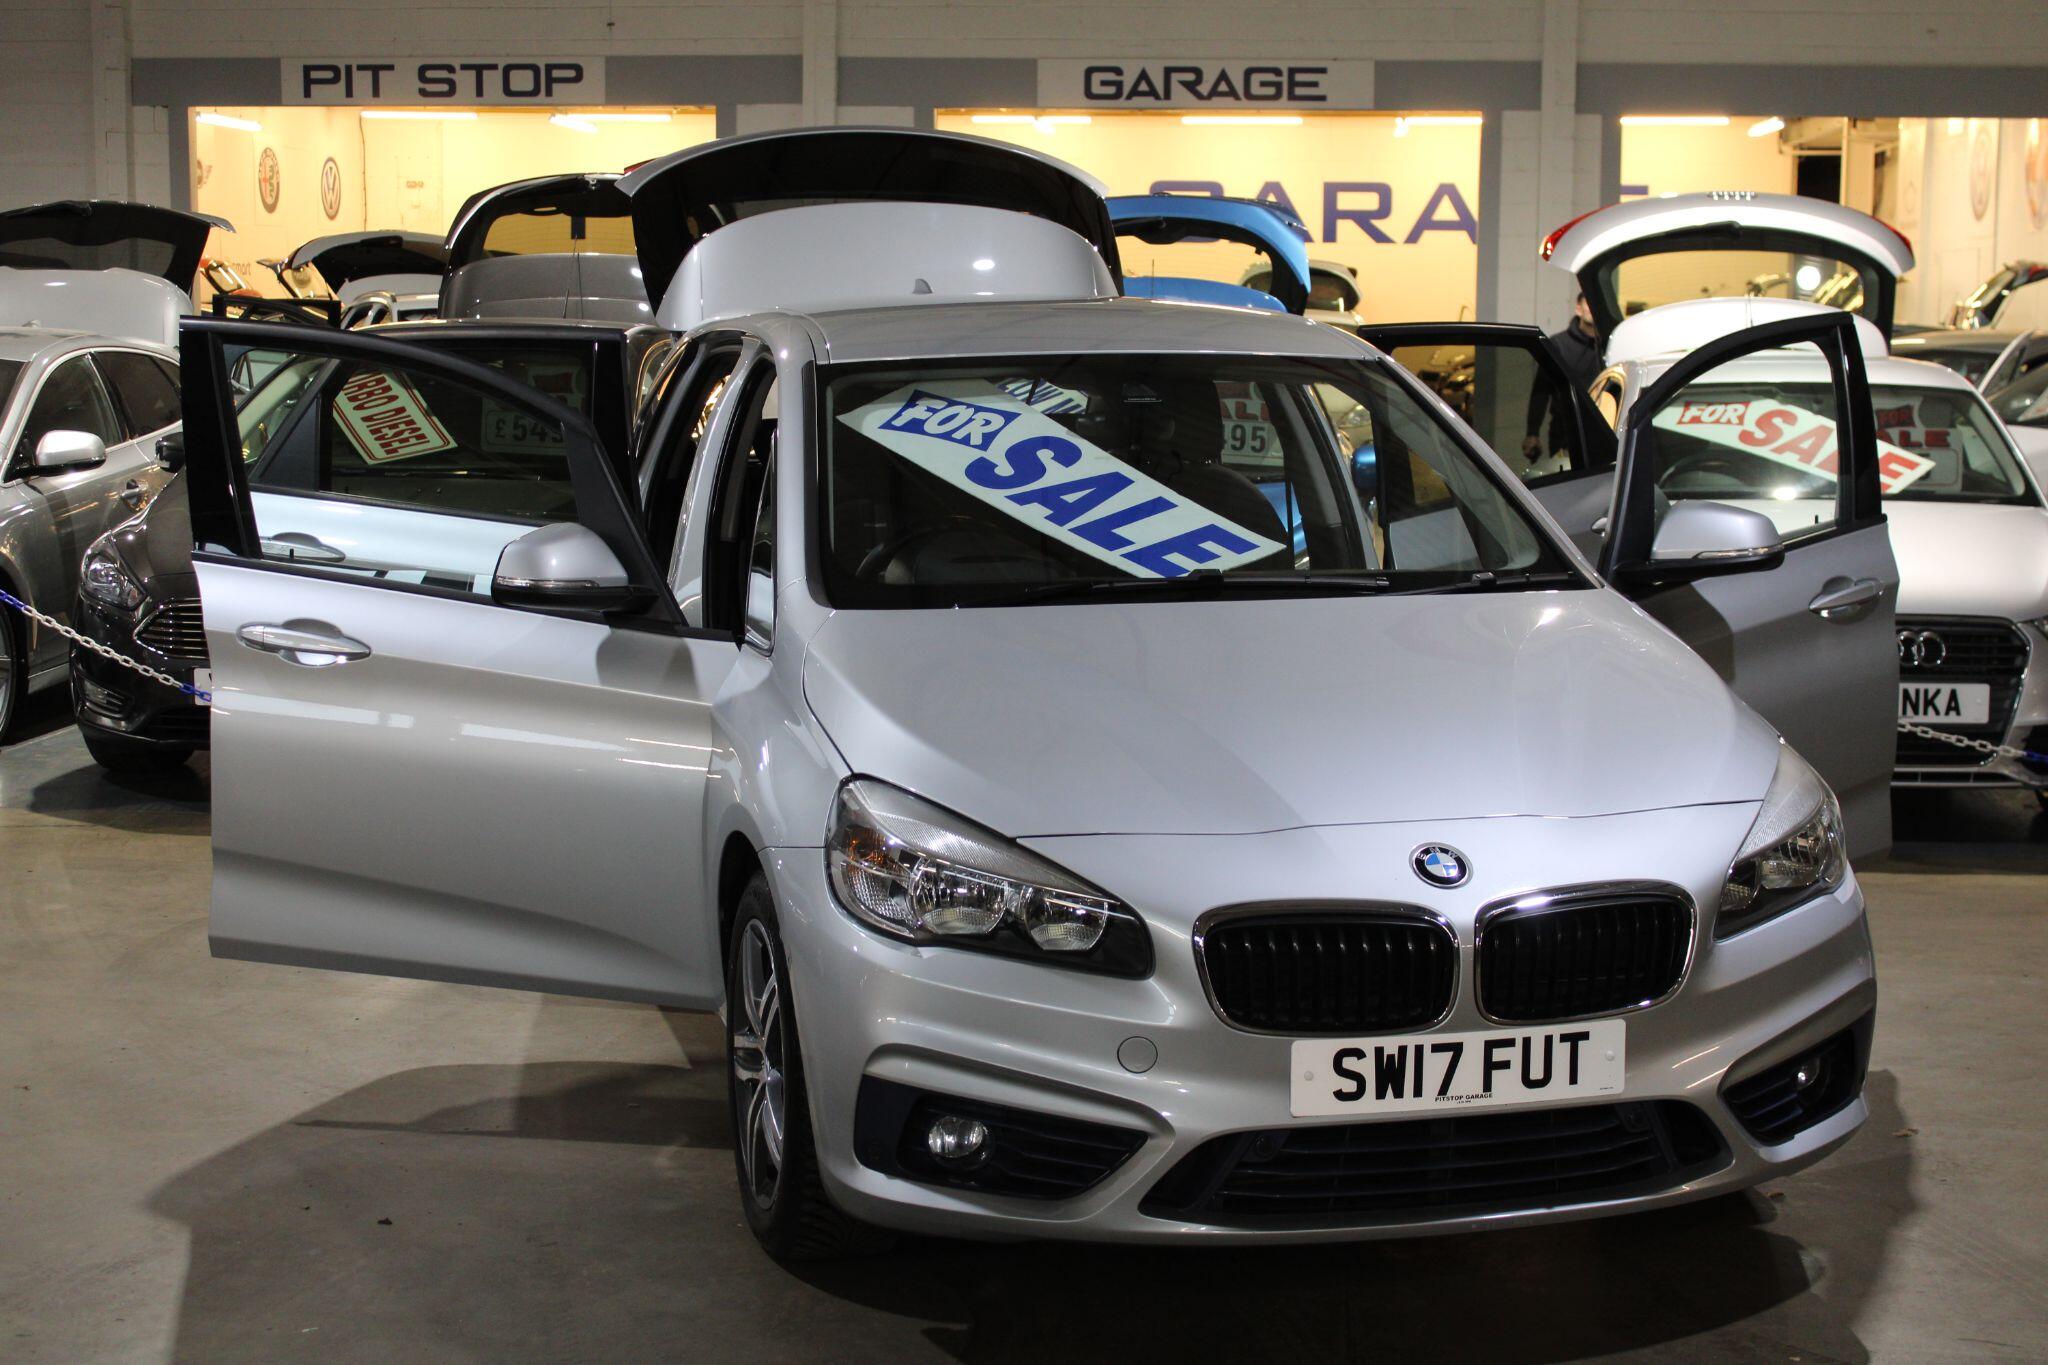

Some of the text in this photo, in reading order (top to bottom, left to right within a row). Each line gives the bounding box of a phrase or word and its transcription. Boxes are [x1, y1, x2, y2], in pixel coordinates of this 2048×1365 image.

[302, 62, 585, 99] PIT STOP
[1083, 65, 1328, 102] GARAGE
[360, 405, 431, 456] DIESEL
[1682, 403, 1745, 424] FOR
[898, 396, 1261, 578] FOR SALE
[1902, 688, 1961, 717] NKA
[1332, 1030, 1590, 1103] SW17 FUT
